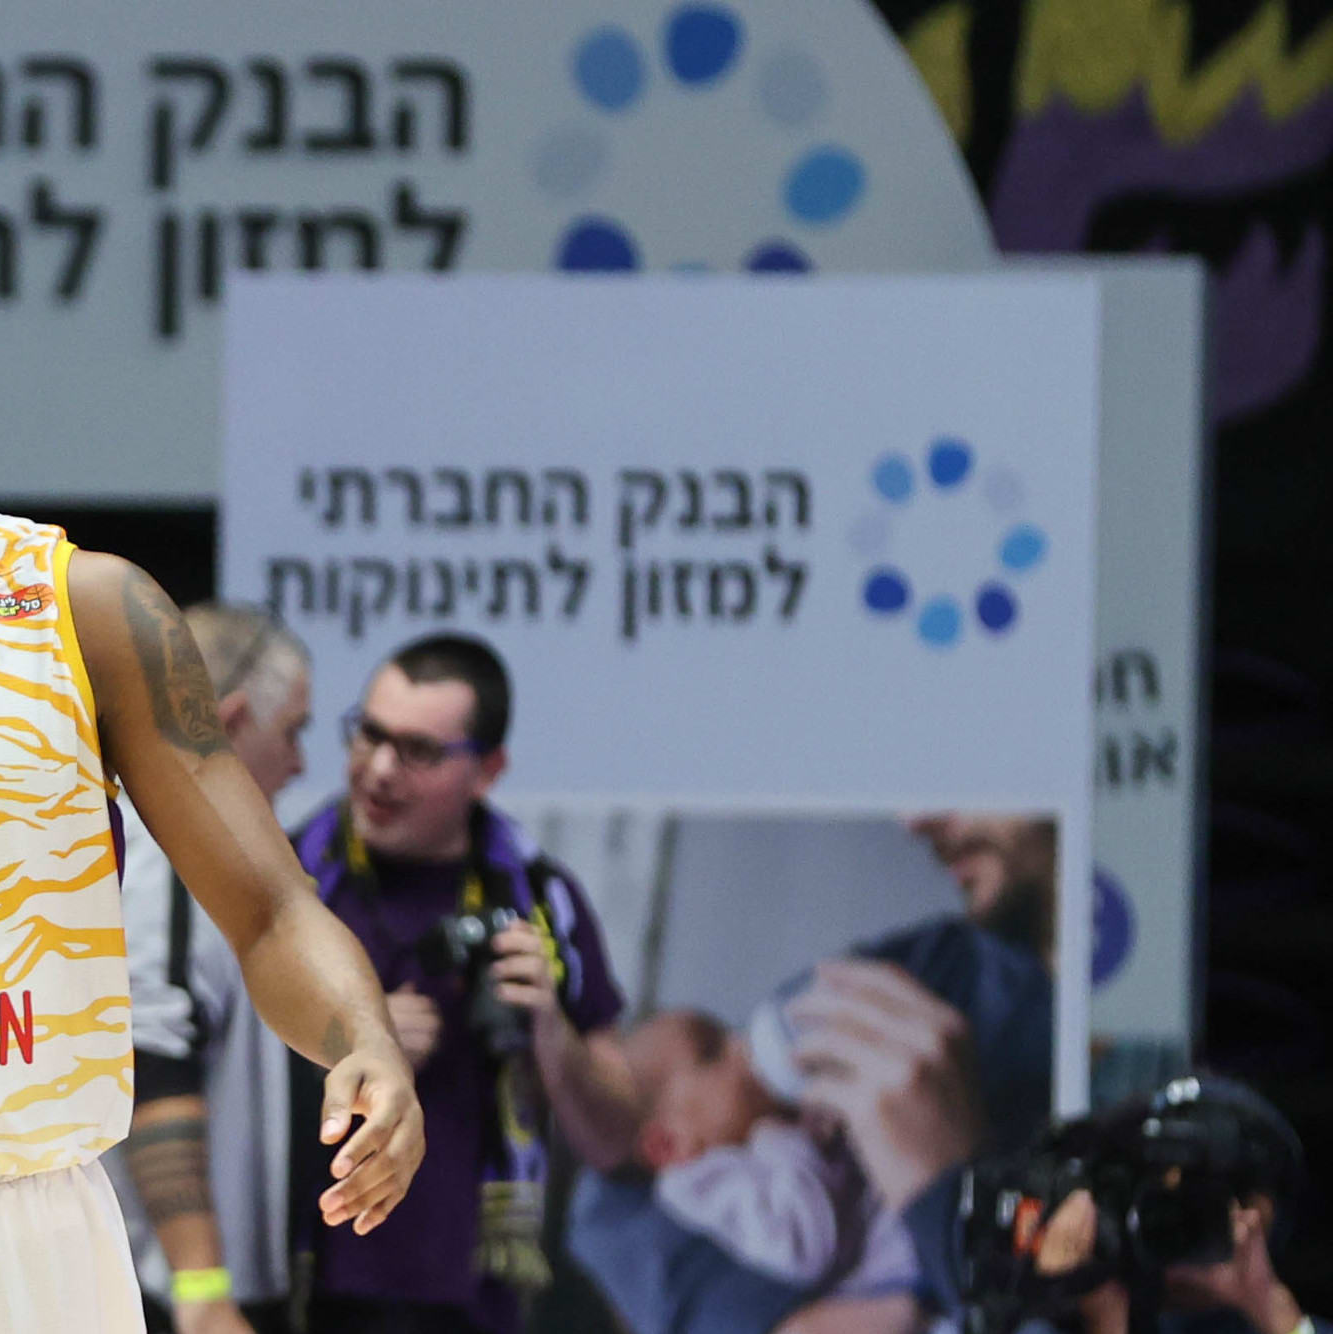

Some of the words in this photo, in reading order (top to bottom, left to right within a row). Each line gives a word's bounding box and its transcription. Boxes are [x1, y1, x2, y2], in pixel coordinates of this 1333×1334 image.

[149, 55, 471, 191] הבנק
[157, 180, 467, 338] למזון
[299, 465, 590, 527] החברתי
[618, 465, 811, 549] הבנק
[265, 544, 591, 640] לתינוקות
[621, 545, 807, 641] למזון
